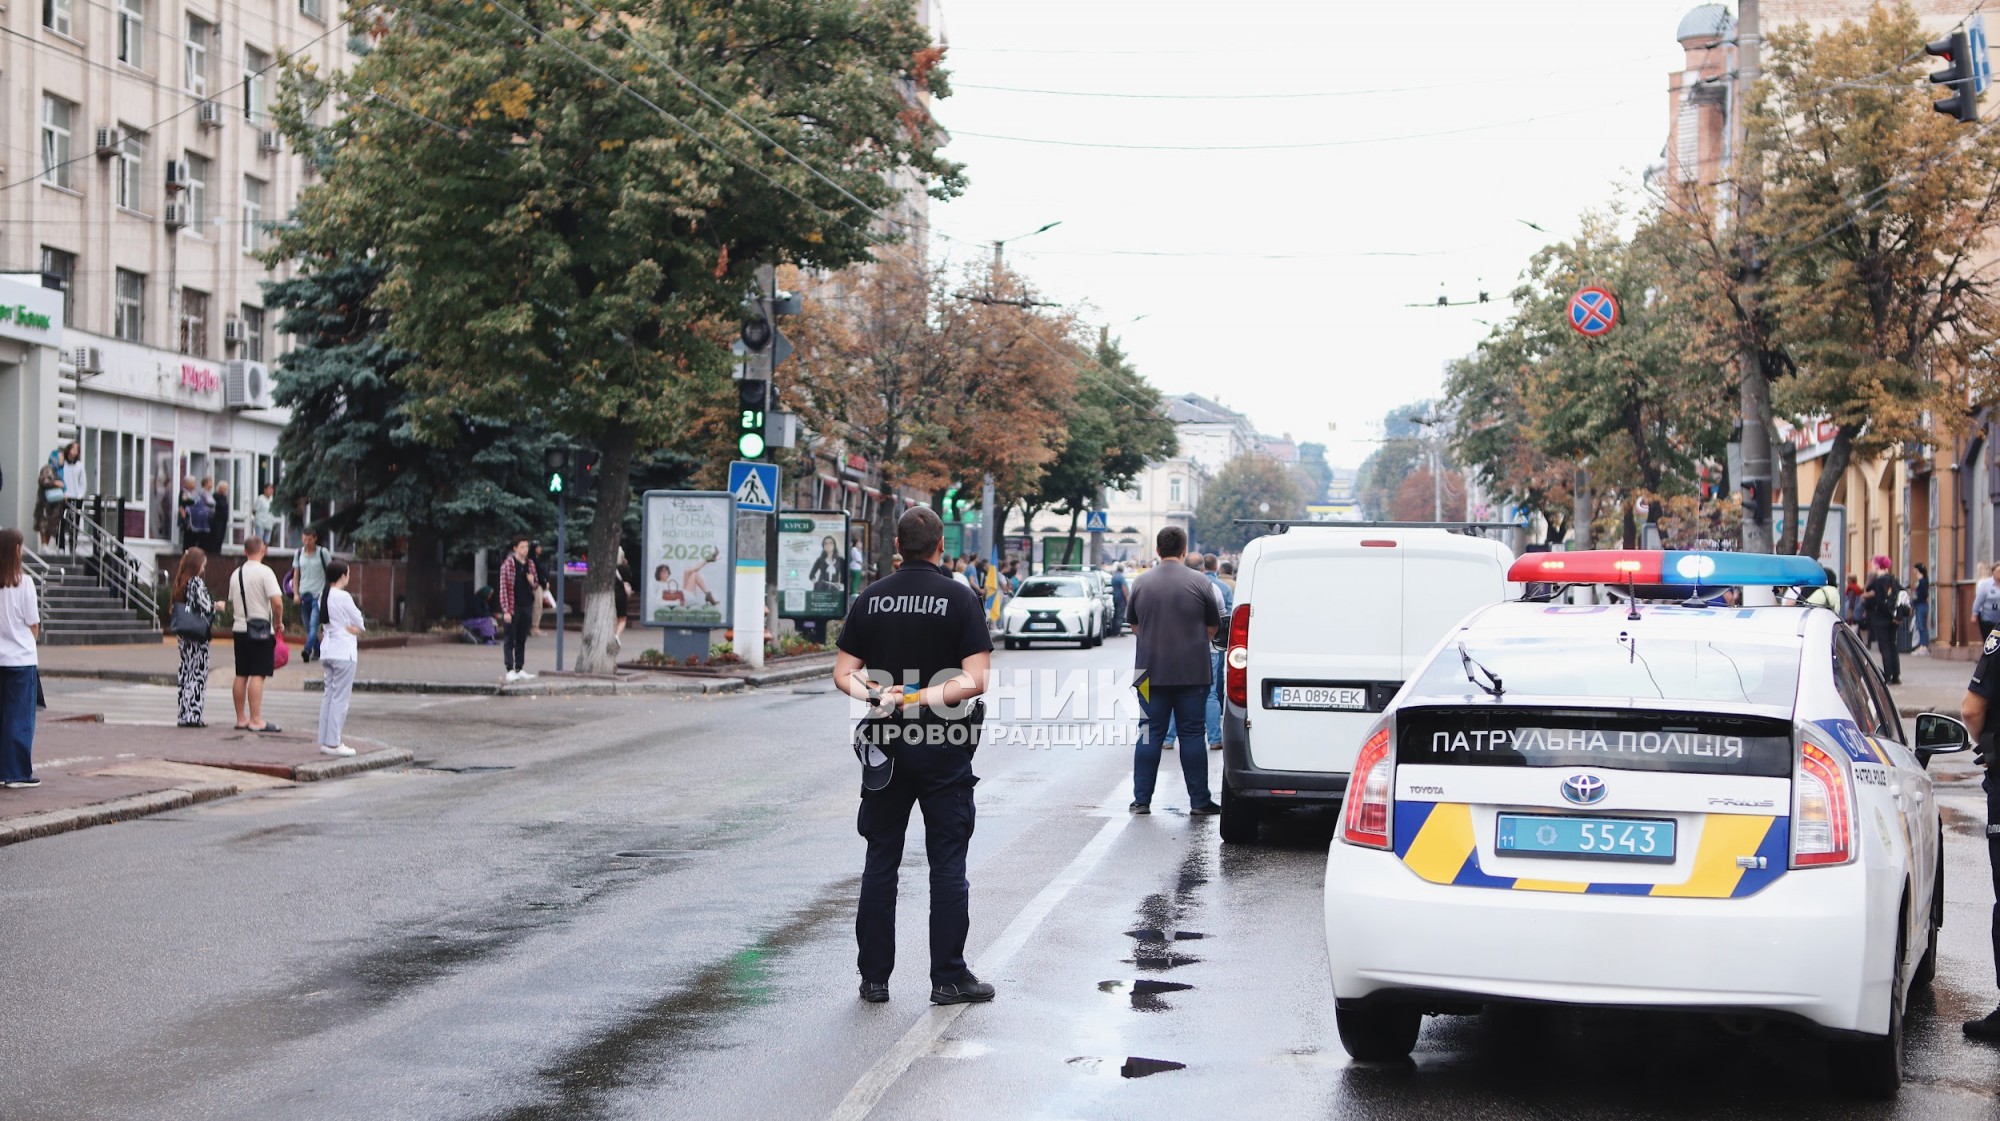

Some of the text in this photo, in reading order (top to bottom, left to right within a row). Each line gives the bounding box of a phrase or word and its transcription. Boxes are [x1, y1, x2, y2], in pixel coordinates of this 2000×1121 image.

[741, 410, 763, 429] 21
[662, 513, 714, 527] НОВА
[784, 522, 809, 530] КУРСИ
[662, 529, 714, 539] КОЛЕКЦІЯ
[662, 543, 713, 561] 2026
[867, 595, 948, 616] ПОЛІЦІЯ
[1305, 689, 1337, 703] 0896
[1432, 729, 1743, 758] ПАТРУЛЬНА ПОЛІЦІЯ
[1409, 785, 1444, 795] TOYOTA
[1501, 823, 1656, 853] 11 5543
